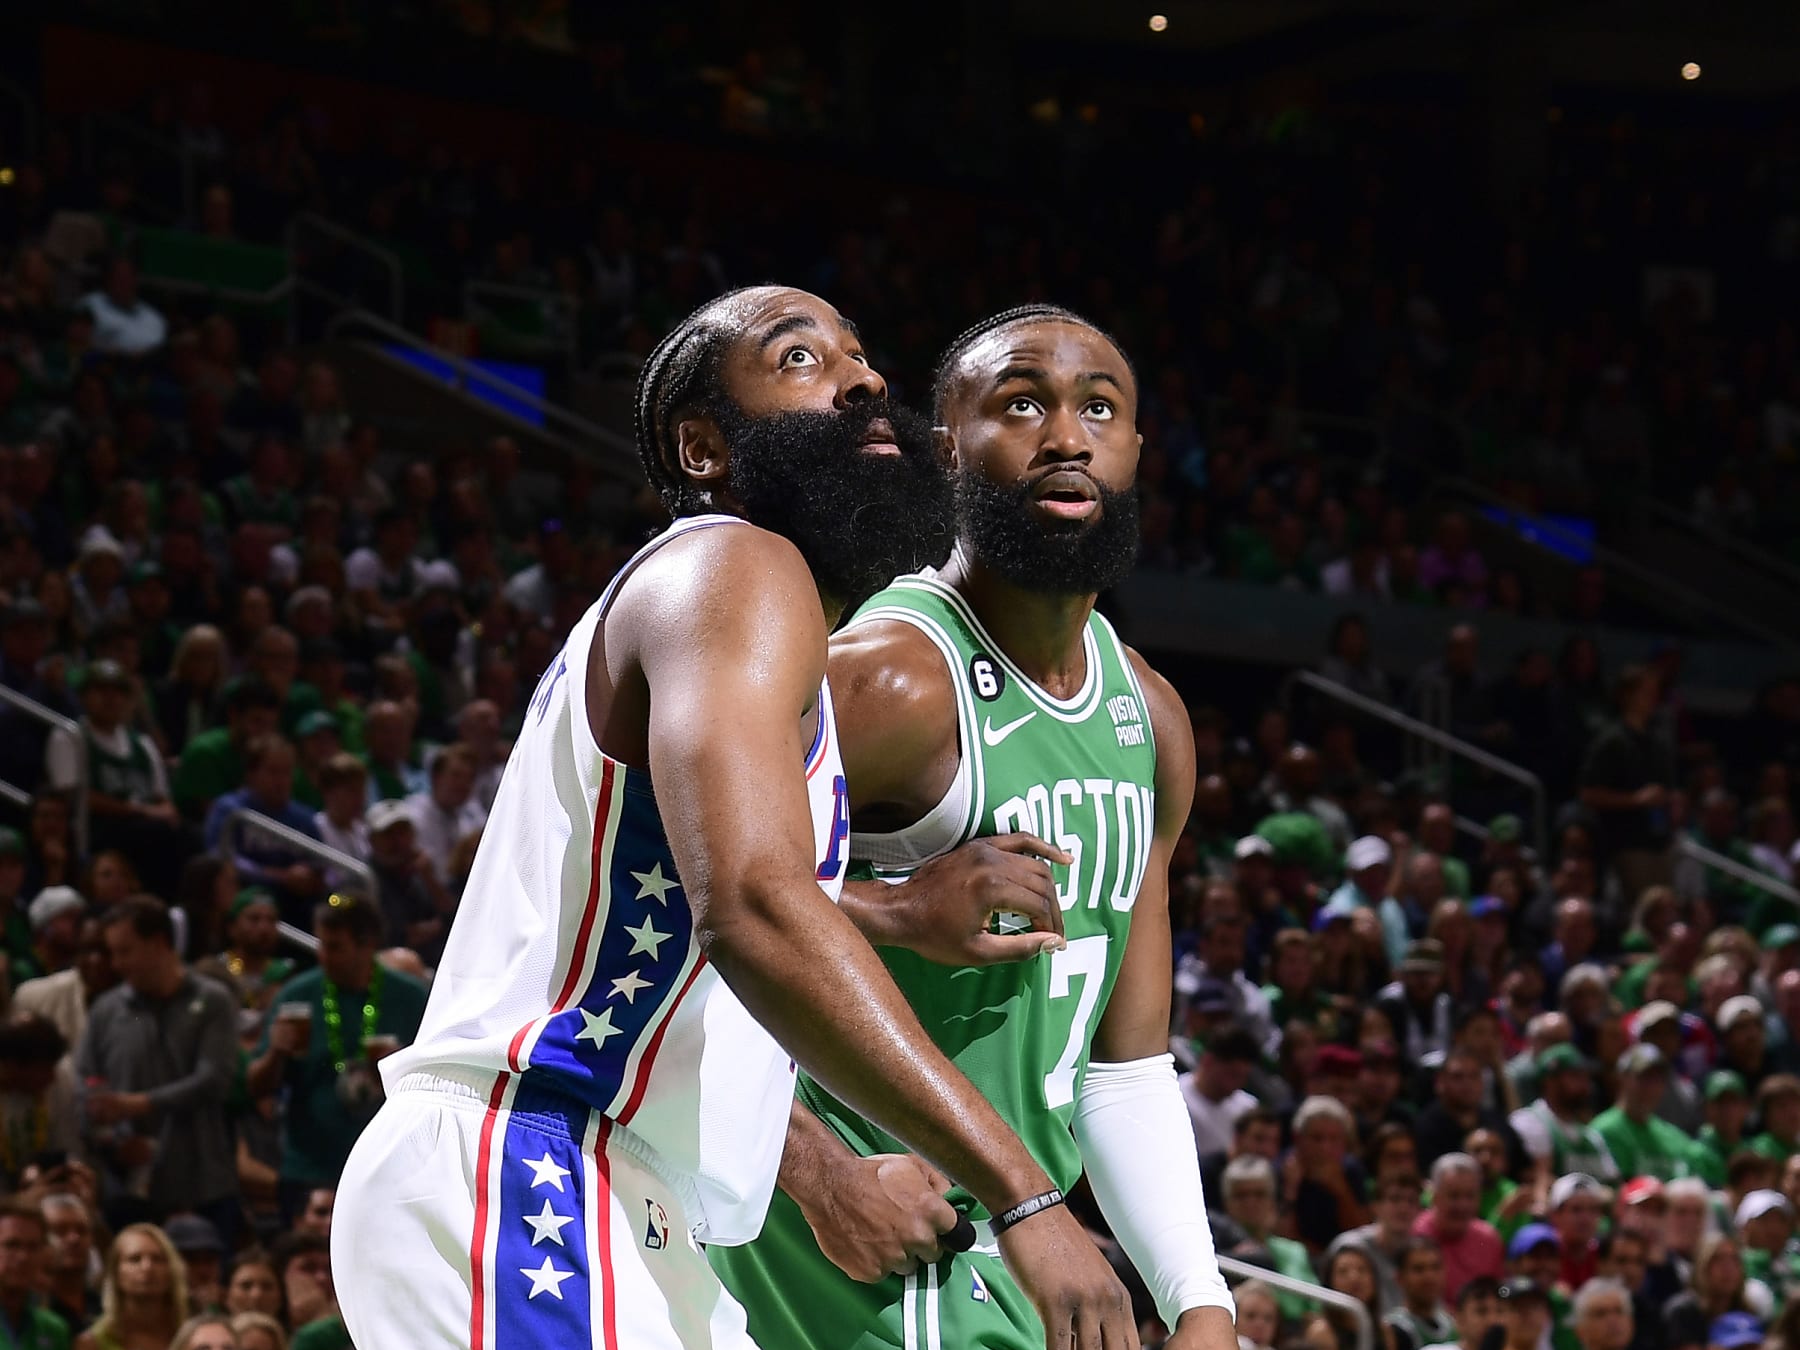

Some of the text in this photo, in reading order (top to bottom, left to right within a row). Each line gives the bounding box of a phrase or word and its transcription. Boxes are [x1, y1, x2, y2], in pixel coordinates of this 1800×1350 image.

[973, 660, 998, 697] 6
[1106, 695, 1142, 725] VISTA
[1115, 723, 1146, 747] PRINT
[1044, 935, 1108, 1109] 7
